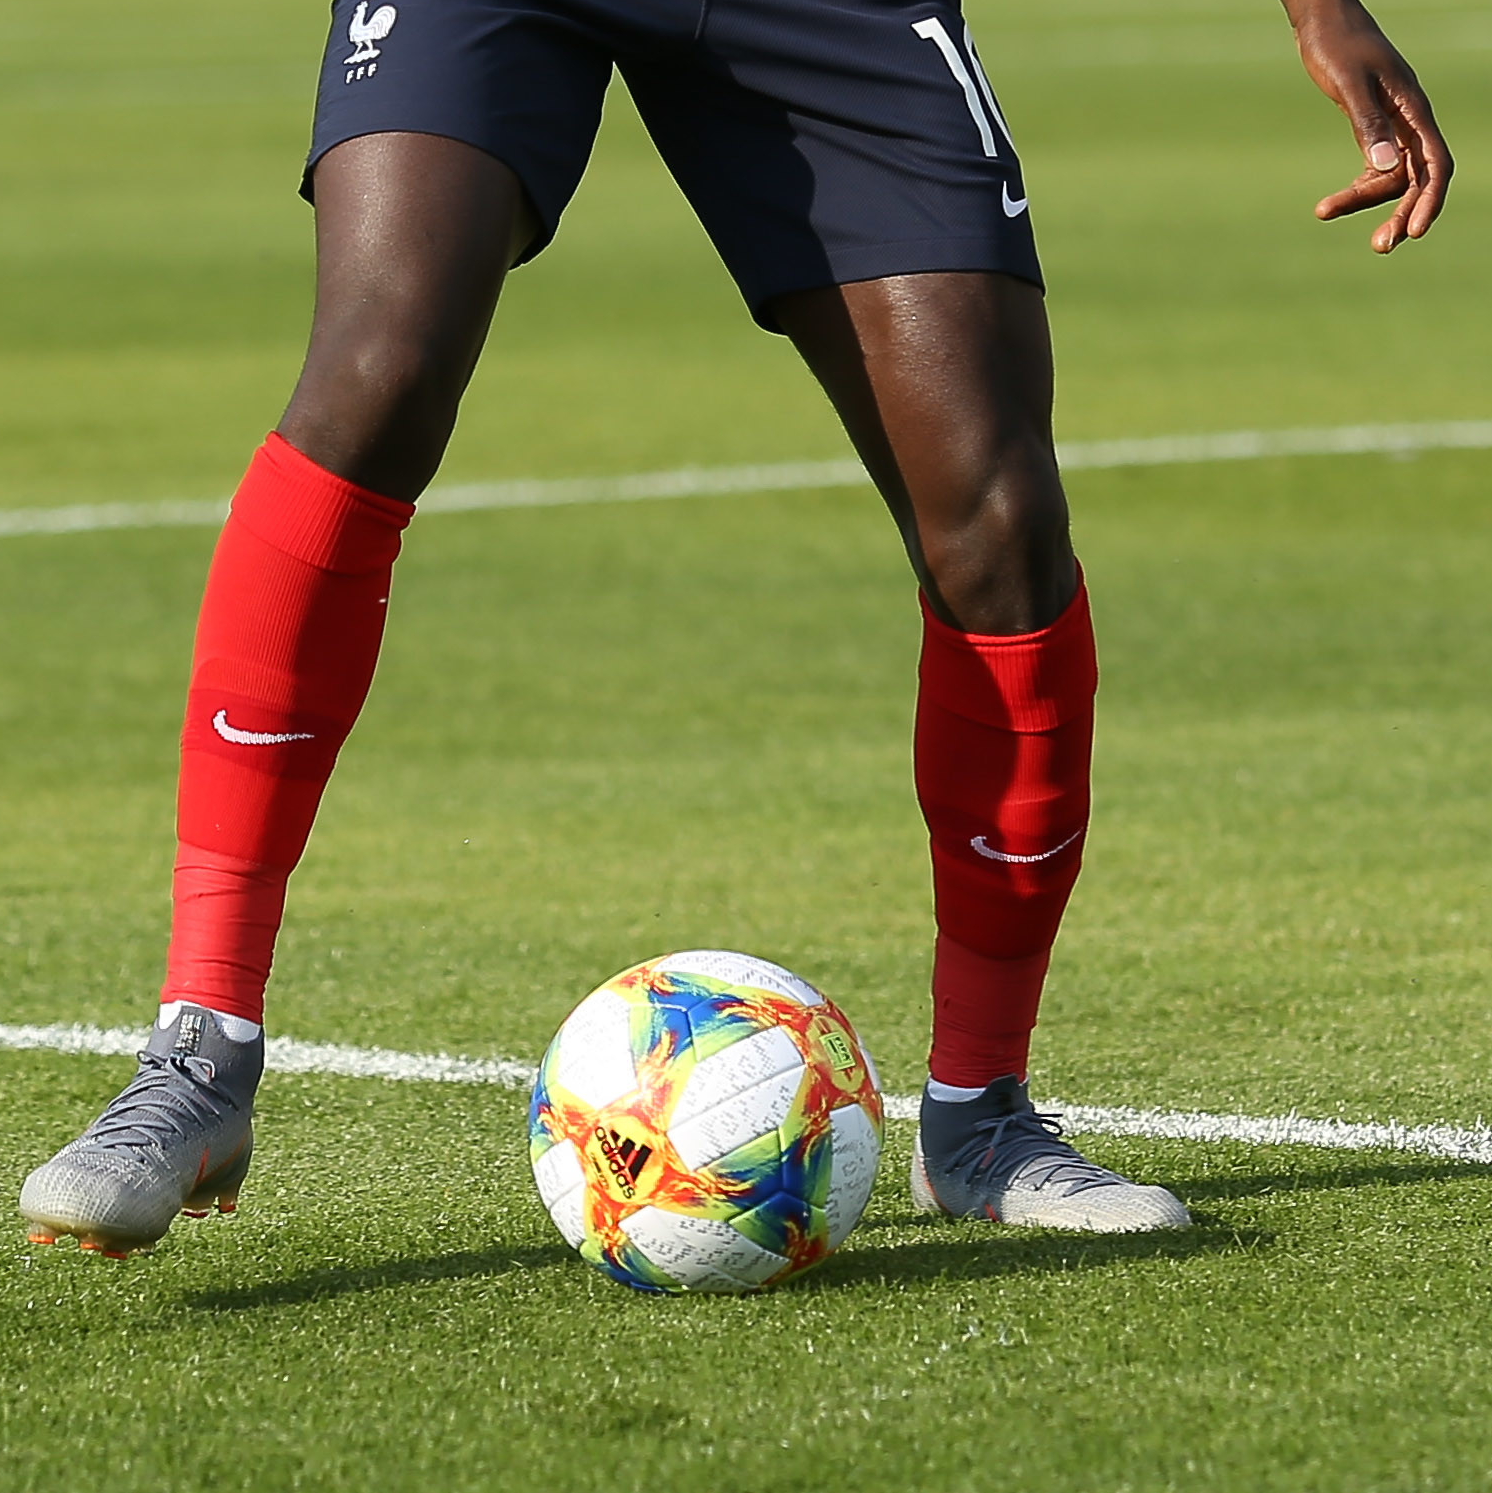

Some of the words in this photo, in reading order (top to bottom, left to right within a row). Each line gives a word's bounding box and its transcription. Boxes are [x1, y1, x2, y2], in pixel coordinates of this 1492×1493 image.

[345, 63, 378, 84] FFF
[911, 17, 1015, 157] 1
[595, 1126, 636, 1199] adidas
